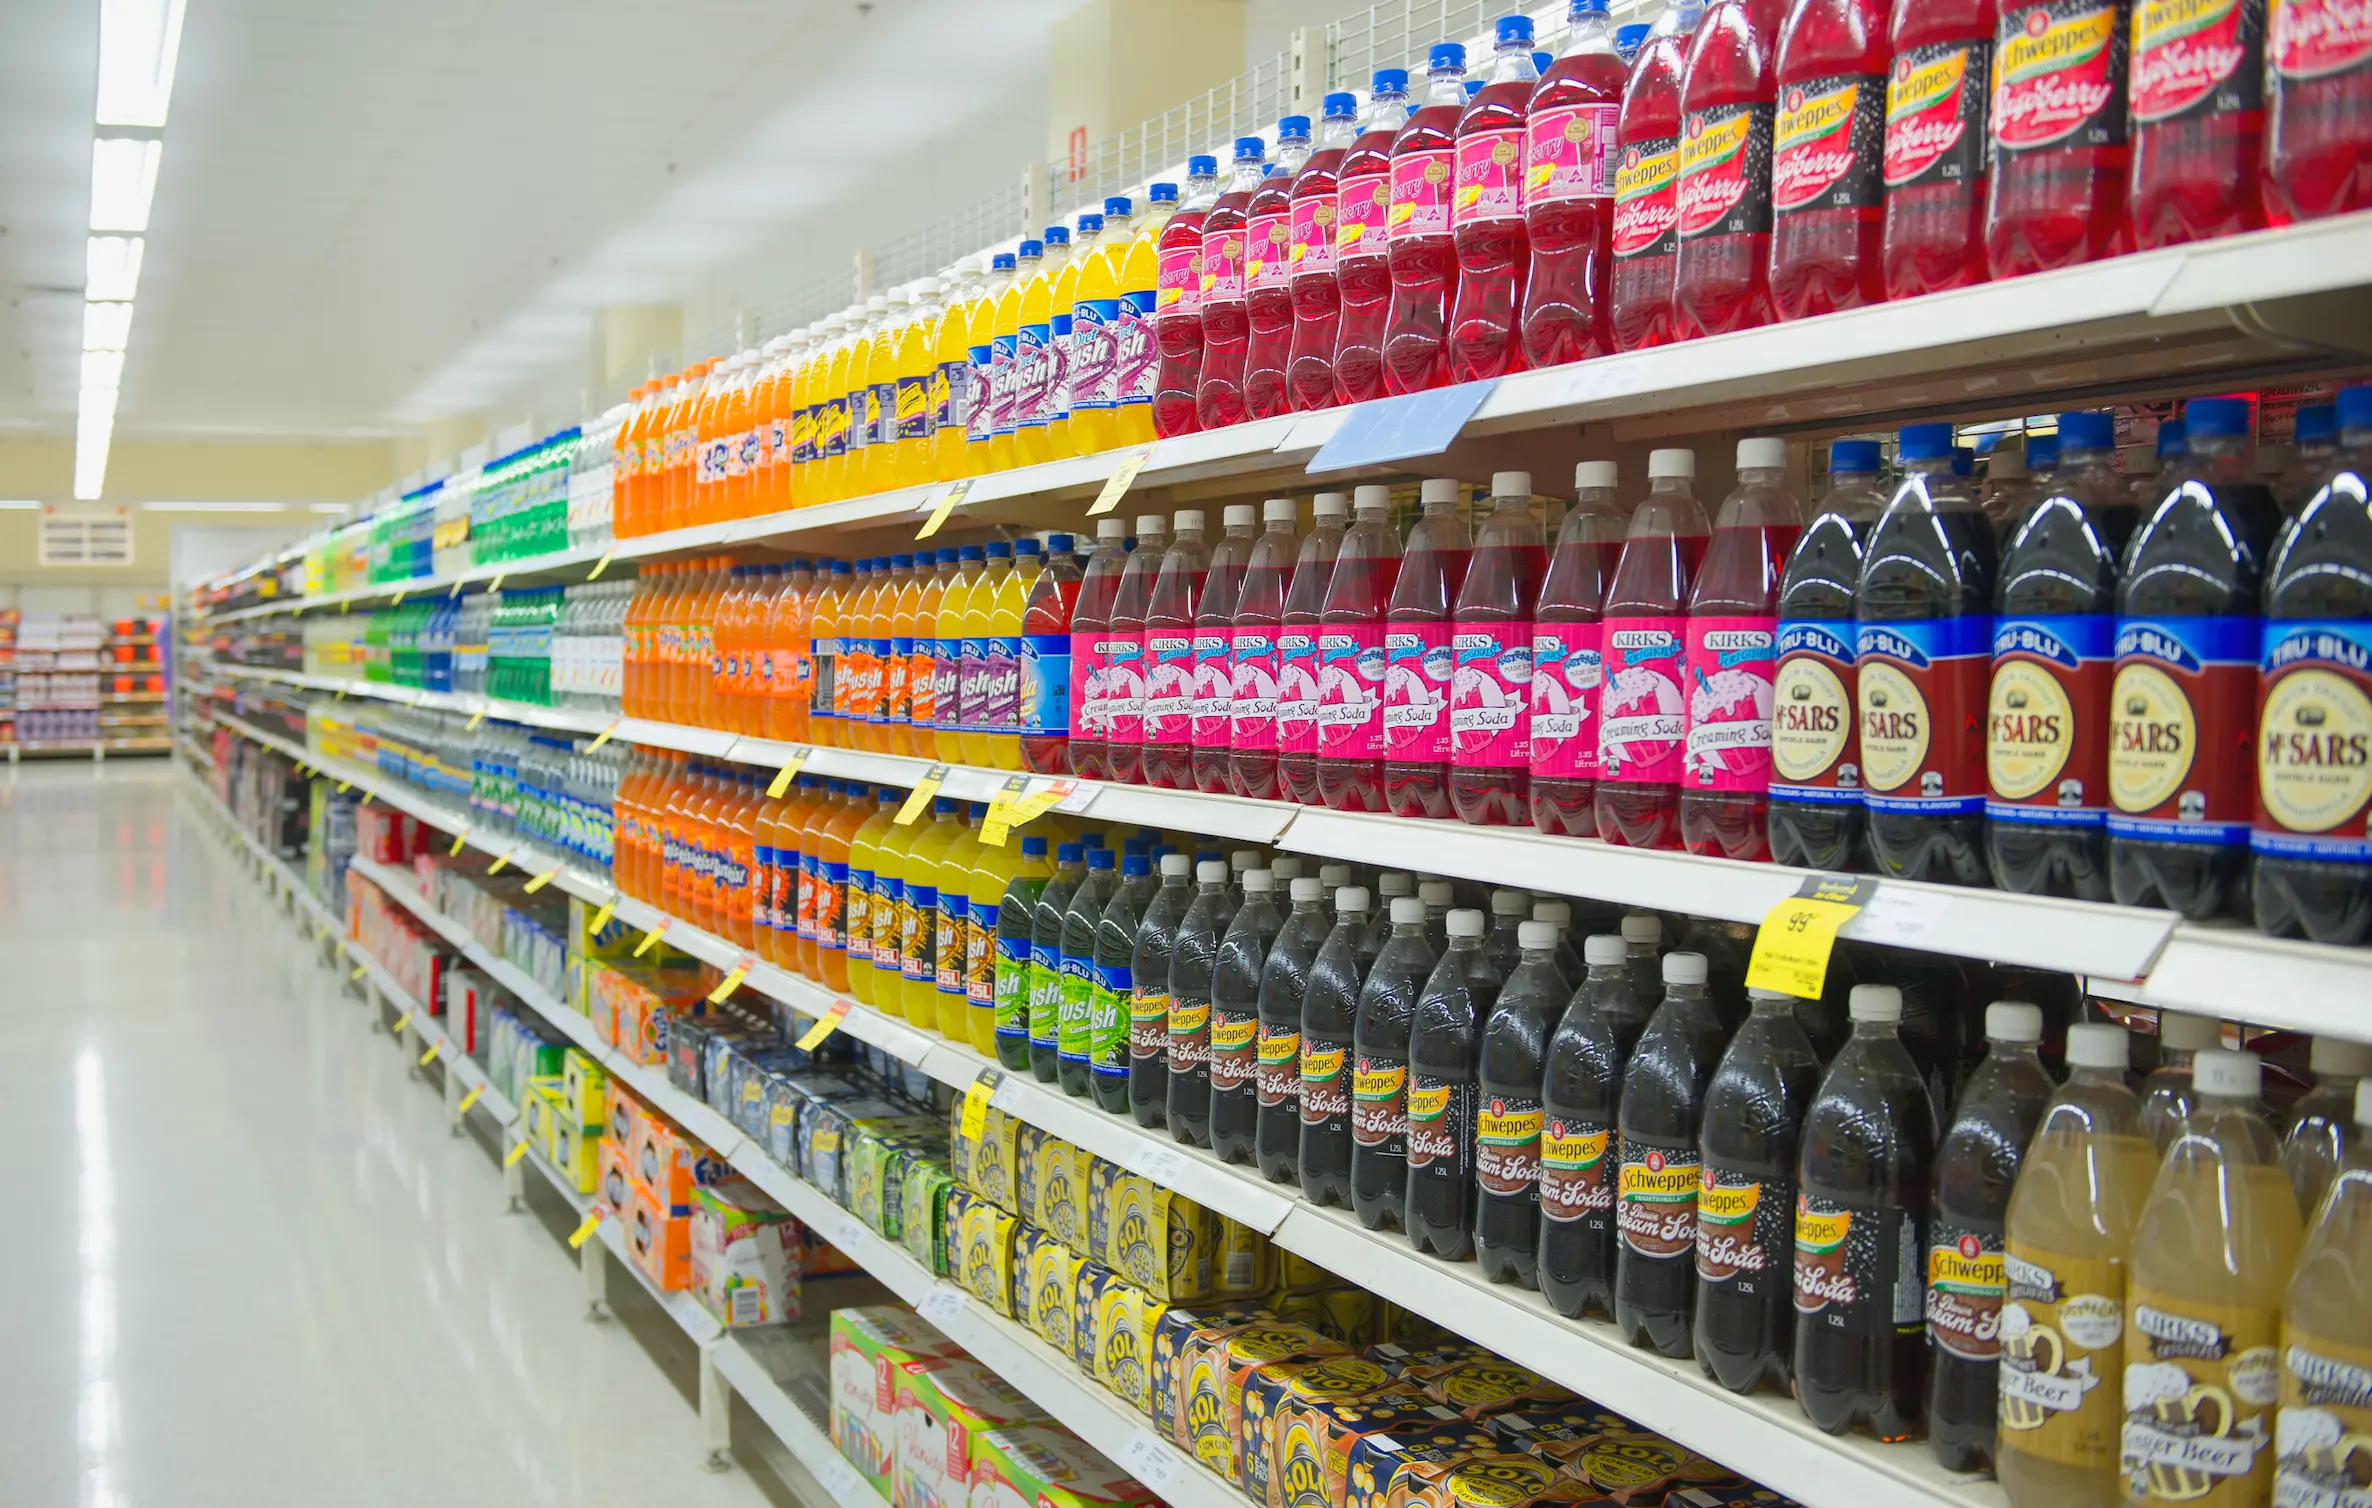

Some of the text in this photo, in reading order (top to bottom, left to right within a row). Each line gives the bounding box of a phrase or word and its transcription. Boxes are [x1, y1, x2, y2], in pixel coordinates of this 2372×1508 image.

[1778, 101, 1844, 143] hweppes
[1684, 126, 1738, 163] hweppes
[1152, 639, 1186, 650] KIRKS
[1616, 633, 1667, 647] KIRKS
[1709, 633, 1767, 648] KIRKS
[1339, 706, 1366, 720] Soda
[1405, 708, 1432, 722] Soda
[1477, 710, 1509, 726] Soda
[1546, 719, 1573, 733] Soda
[1514, 741, 1529, 749] 1.25
[1690, 726, 1746, 751] Creaming
[1578, 751, 1593, 759] 1.25
[1179, 1042, 1214, 1062] Soda
[1196, 1070, 1208, 1079] 1.25L
[1223, 1057, 1259, 1079] Soda
[1243, 1087, 1255, 1096] 1.25L
[1286, 1104, 1298, 1113] 1.25L
[1310, 1090, 1349, 1114] Soda
[1329, 1123, 1342, 1132] 1.25L
[1367, 1109, 1409, 1135] Soda
[1389, 1144, 1402, 1153] 1.25L
[1412, 1130, 1454, 1157] Soda
[1435, 1167, 1448, 1177] 1.25L
[1623, 1168, 1699, 1191] Schweppes
[1561, 1180, 1611, 1208] Soda
[1634, 1195, 1681, 1203] TRADITIONALS
[1630, 1204, 1659, 1221] Brown
[1092, 1221, 1098, 1239] 6
[1589, 1219, 1604, 1230] 1.25L
[1710, 1236, 1765, 1270] Soda
[1738, 1282, 1754, 1293] 1.25L
[1802, 1266, 1856, 1302] Soda
[1828, 1314, 1845, 1327] 1.25L
[1079, 1331, 1085, 1349] 6
[877, 1358, 888, 1384] 12
[2024, 1376, 2070, 1403] Beer
[1155, 1390, 1164, 1411] 6
[1188, 1395, 1229, 1436] SOLO
[948, 1420, 960, 1451] 12
[1246, 1452, 1254, 1474] 6
[1595, 1443, 1678, 1474] SOLO
[1600, 1456, 1628, 1468] LOW
[2183, 1442, 2241, 1467] Beer
[1283, 1461, 1331, 1503] SOLO
[1464, 1464, 1547, 1496] SOLO
